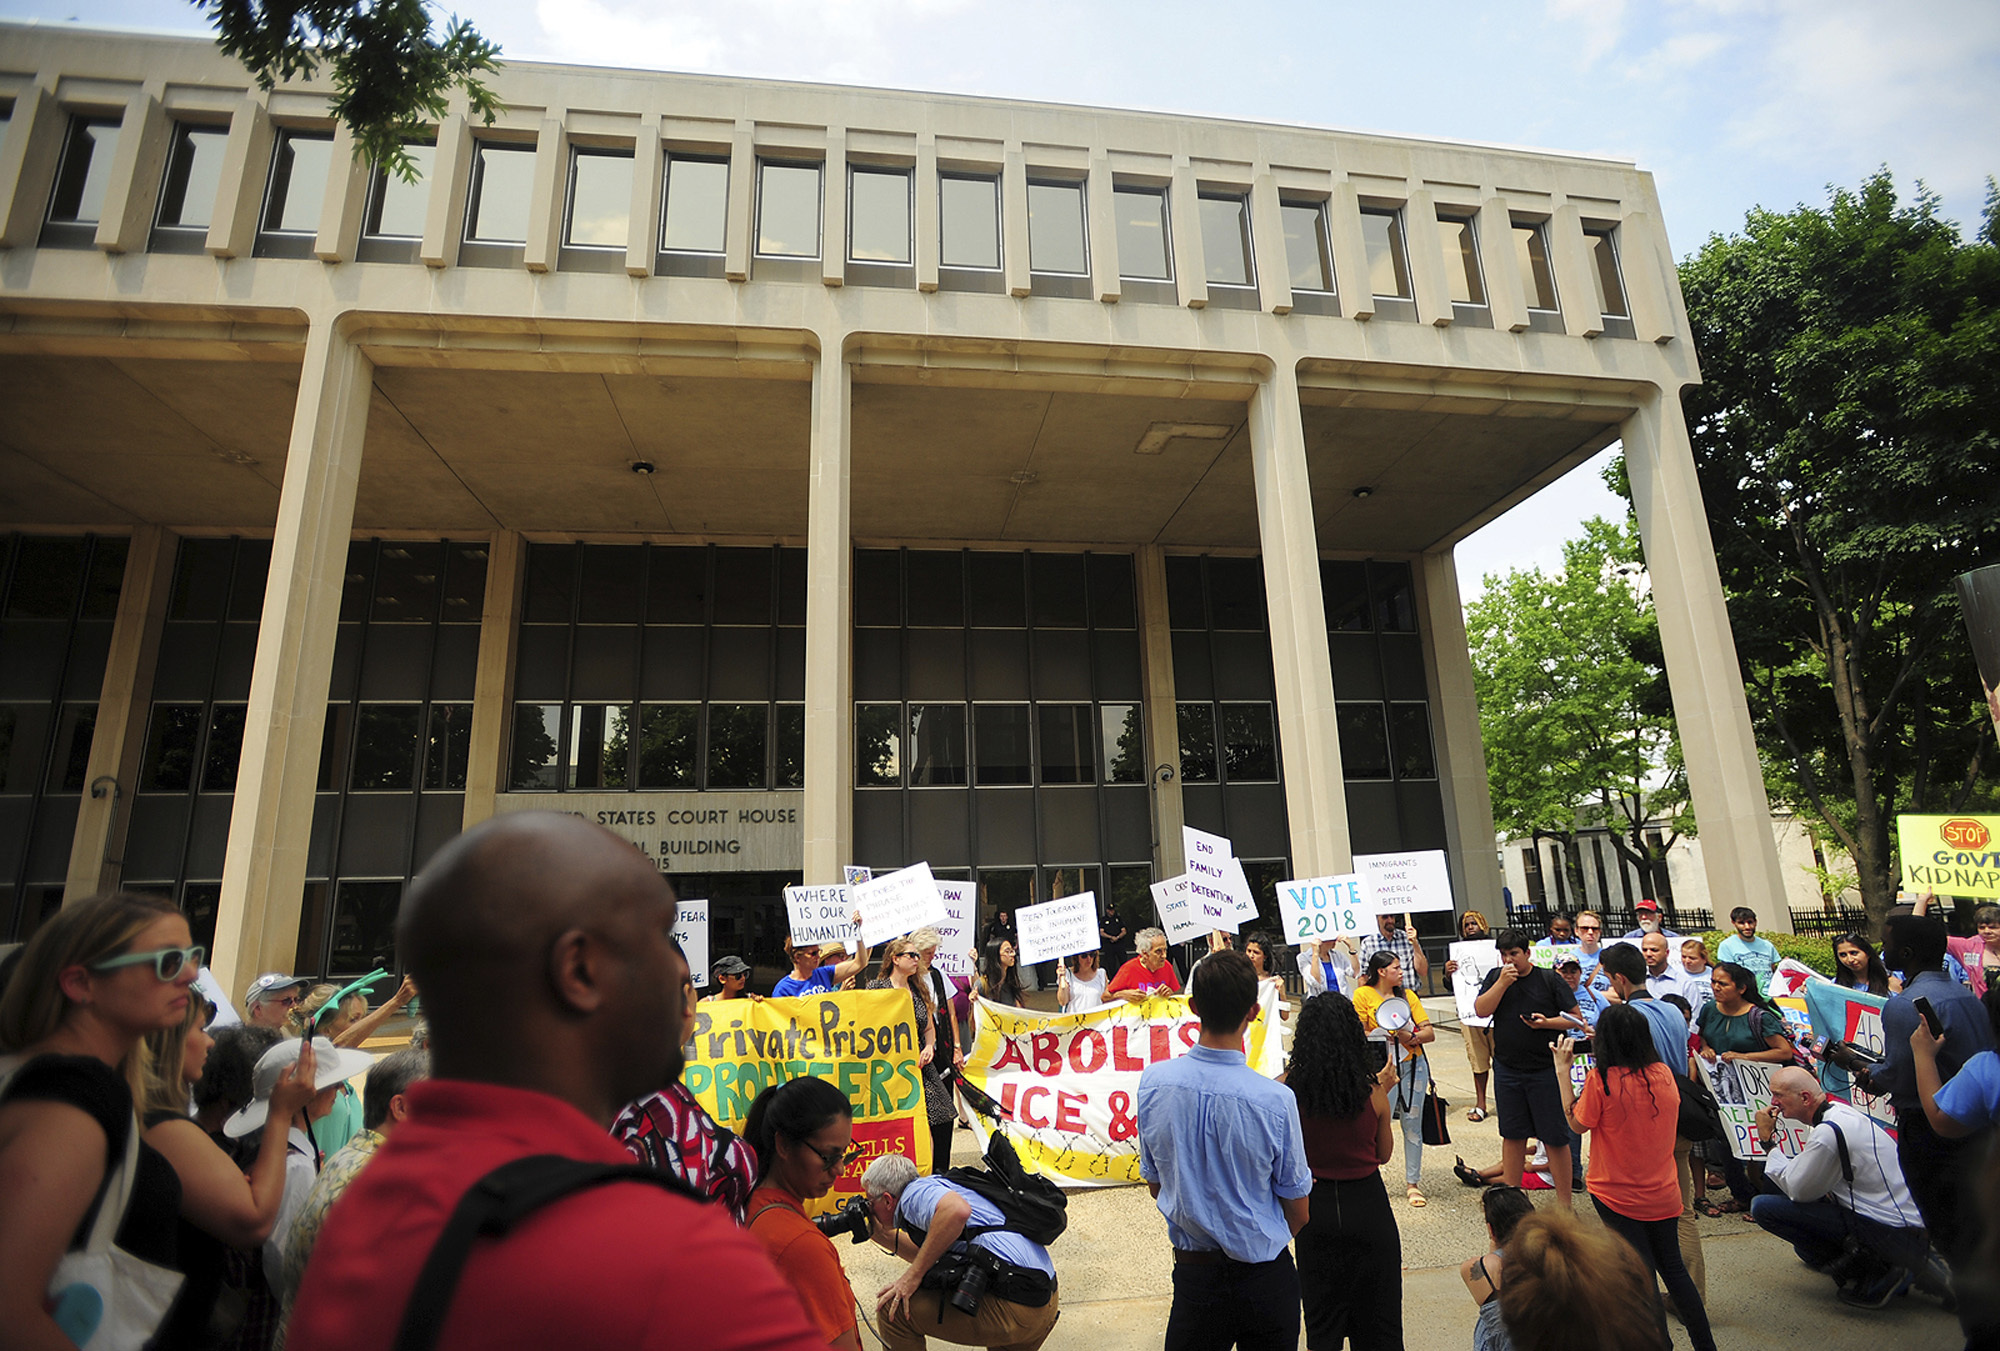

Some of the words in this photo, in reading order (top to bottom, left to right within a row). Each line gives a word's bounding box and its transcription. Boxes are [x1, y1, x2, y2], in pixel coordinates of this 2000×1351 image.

[597, 810, 656, 825] STATES
[668, 810, 728, 824] COURT
[739, 809, 796, 823] HOUSE
[1946, 826, 1986, 843] STOP
[660, 840, 741, 855] BUILDING
[1196, 841, 1213, 854] END
[1189, 860, 1223, 878] FAMILY
[1369, 859, 1418, 869] IMMIGRANTS
[1384, 872, 1407, 880] MAKE
[793, 889, 848, 902] WHERE
[1191, 881, 1233, 904] DETENTION
[1288, 881, 1361, 910] VOTE
[1377, 884, 1418, 893] AMERICA
[1166, 900, 1188, 912] STATE
[1382, 897, 1412, 906] BETTER
[681, 911, 706, 922] FEAR
[800, 906, 812, 919] IS
[820, 906, 846, 919] OUR
[864, 911, 890, 923] AMILY
[945, 908, 964, 919] ALL
[1022, 912, 1043, 921] ZERO
[1203, 903, 1222, 917] NOW
[1297, 910, 1356, 938] 2018
[792, 922, 858, 942] HUMANITY?
[1027, 931, 1070, 945] TREATMENT
[1037, 939, 1085, 956] IMMIGRANTS
[1536, 948, 1552, 958] NO
[934, 953, 958, 962] STICE
[682, 1012, 817, 1060] Private
[820, 1001, 912, 1058] Prison
[991, 1022, 1201, 1077] ABOLIS
[685, 1059, 920, 1121] PROERS
[1000, 1083, 1088, 1134] ICE
[842, 1136, 905, 1157] WELLS
[1735, 1125, 1806, 1156] PEPLE
